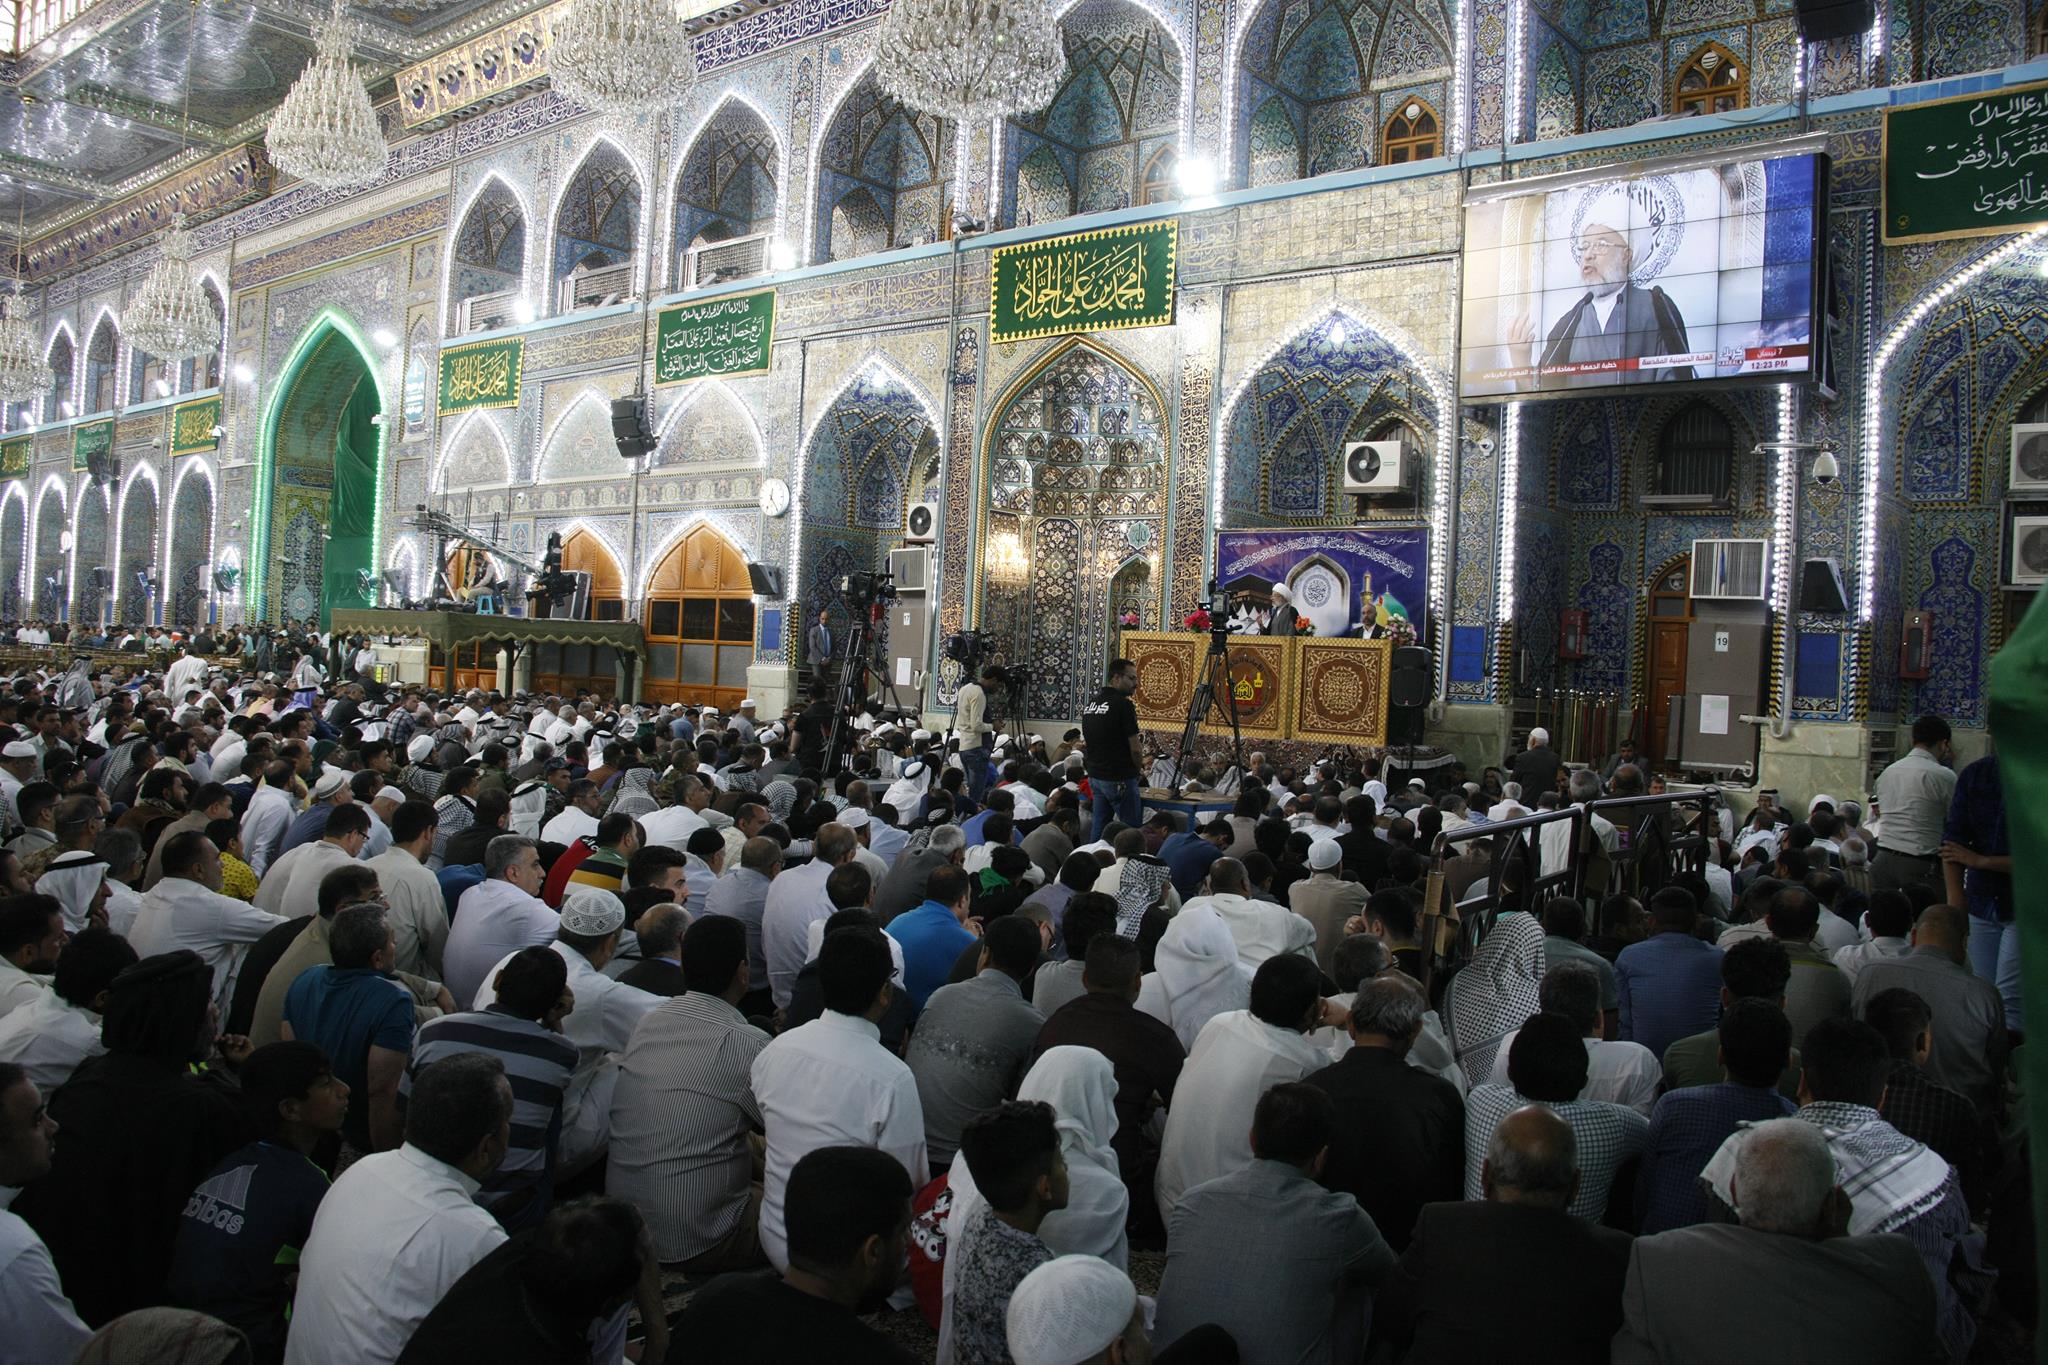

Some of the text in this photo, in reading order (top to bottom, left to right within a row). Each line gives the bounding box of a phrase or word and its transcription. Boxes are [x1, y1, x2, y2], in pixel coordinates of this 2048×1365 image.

[1969, 98, 2020, 126] السلام
[1751, 360, 1788, 370] 12:23 PM
[1717, 637, 1728, 646] 19
[1084, 701, 1110, 715] كربلاء
